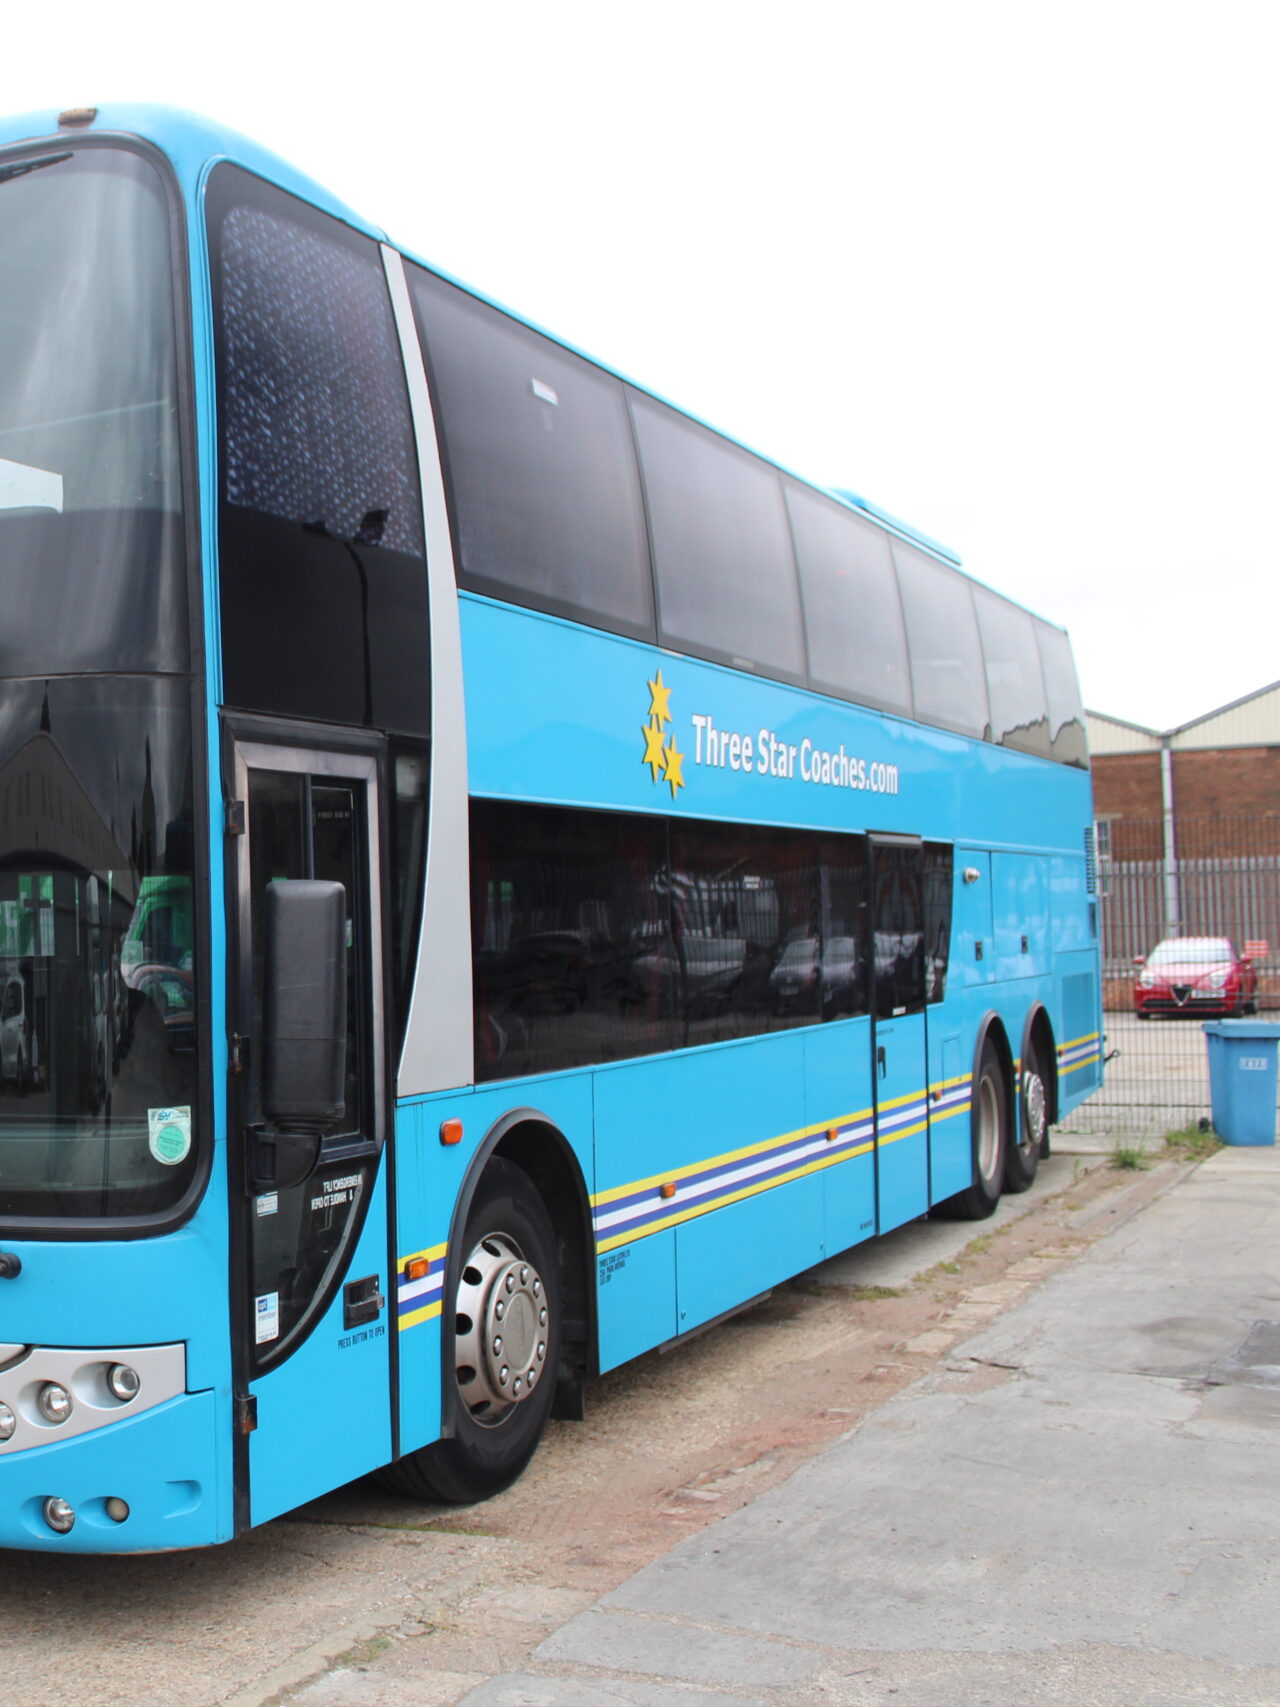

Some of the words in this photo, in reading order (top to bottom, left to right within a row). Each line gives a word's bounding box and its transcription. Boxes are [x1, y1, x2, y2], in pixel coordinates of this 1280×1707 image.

[691, 714, 753, 772] Three
[757, 729, 797, 778] Star
[800, 736, 899, 795] Coaches.com
[338, 1336, 351, 1350] PRESS
[352, 1331, 368, 1345] BUTTON
[375, 1326, 385, 1338] OPEN
